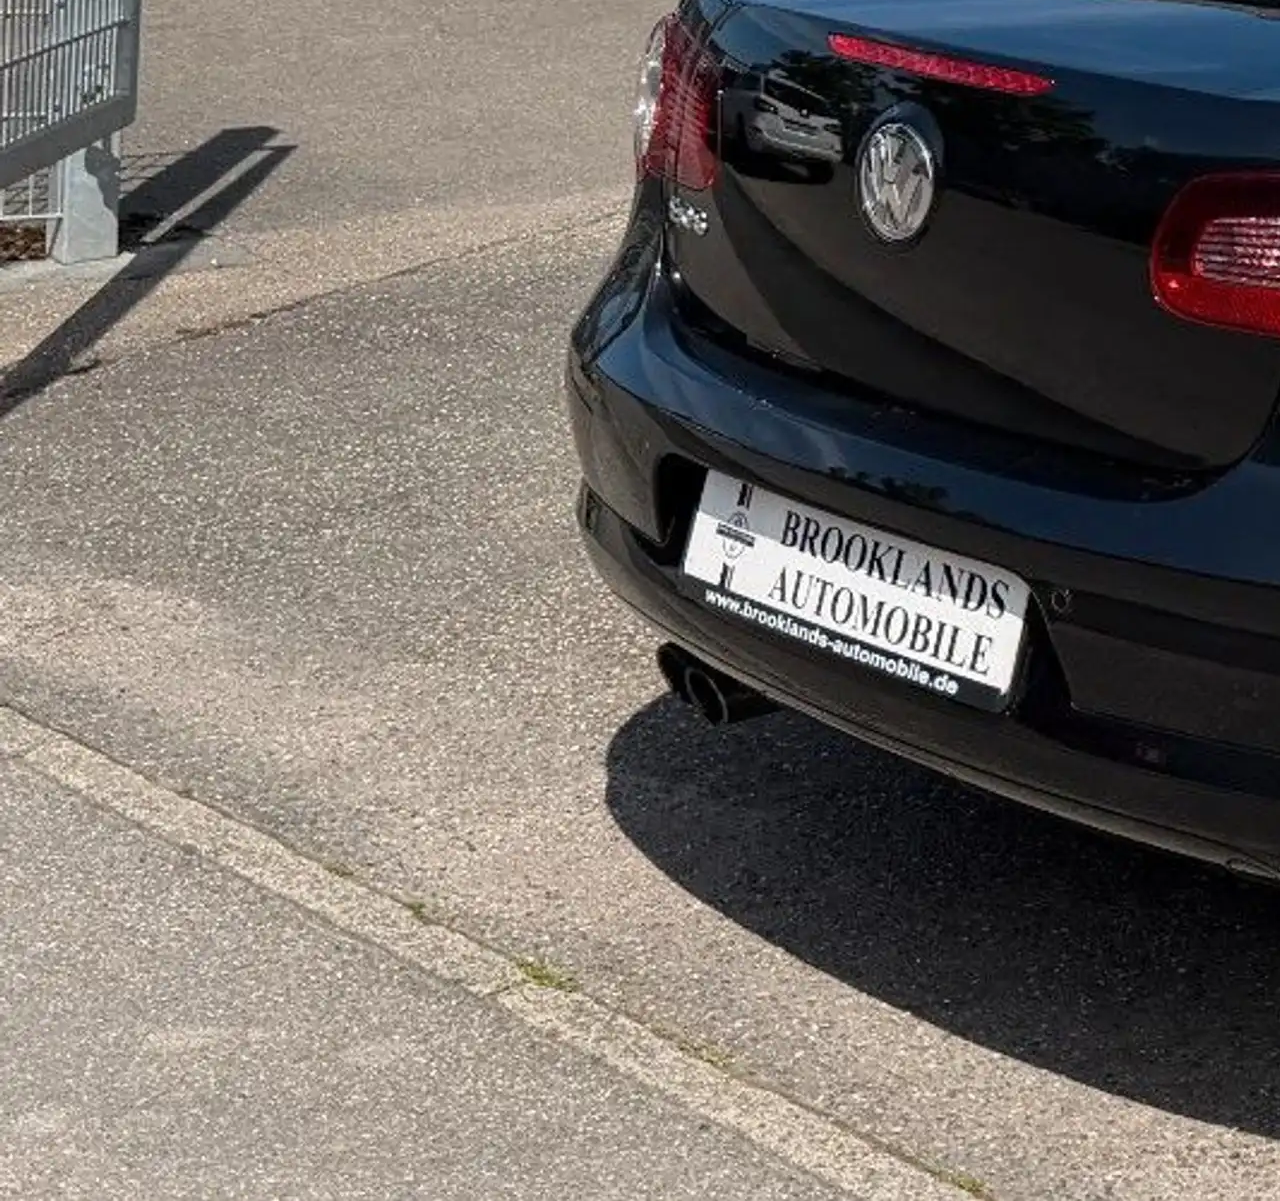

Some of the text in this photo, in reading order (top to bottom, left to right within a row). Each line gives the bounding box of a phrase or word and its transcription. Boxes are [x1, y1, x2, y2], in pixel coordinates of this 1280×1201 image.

[780, 508, 1011, 620] BROOKLANDS
[705, 588, 959, 695] www.brooklands-automobile.de
[767, 566, 994, 677] AUTOMOBILE
